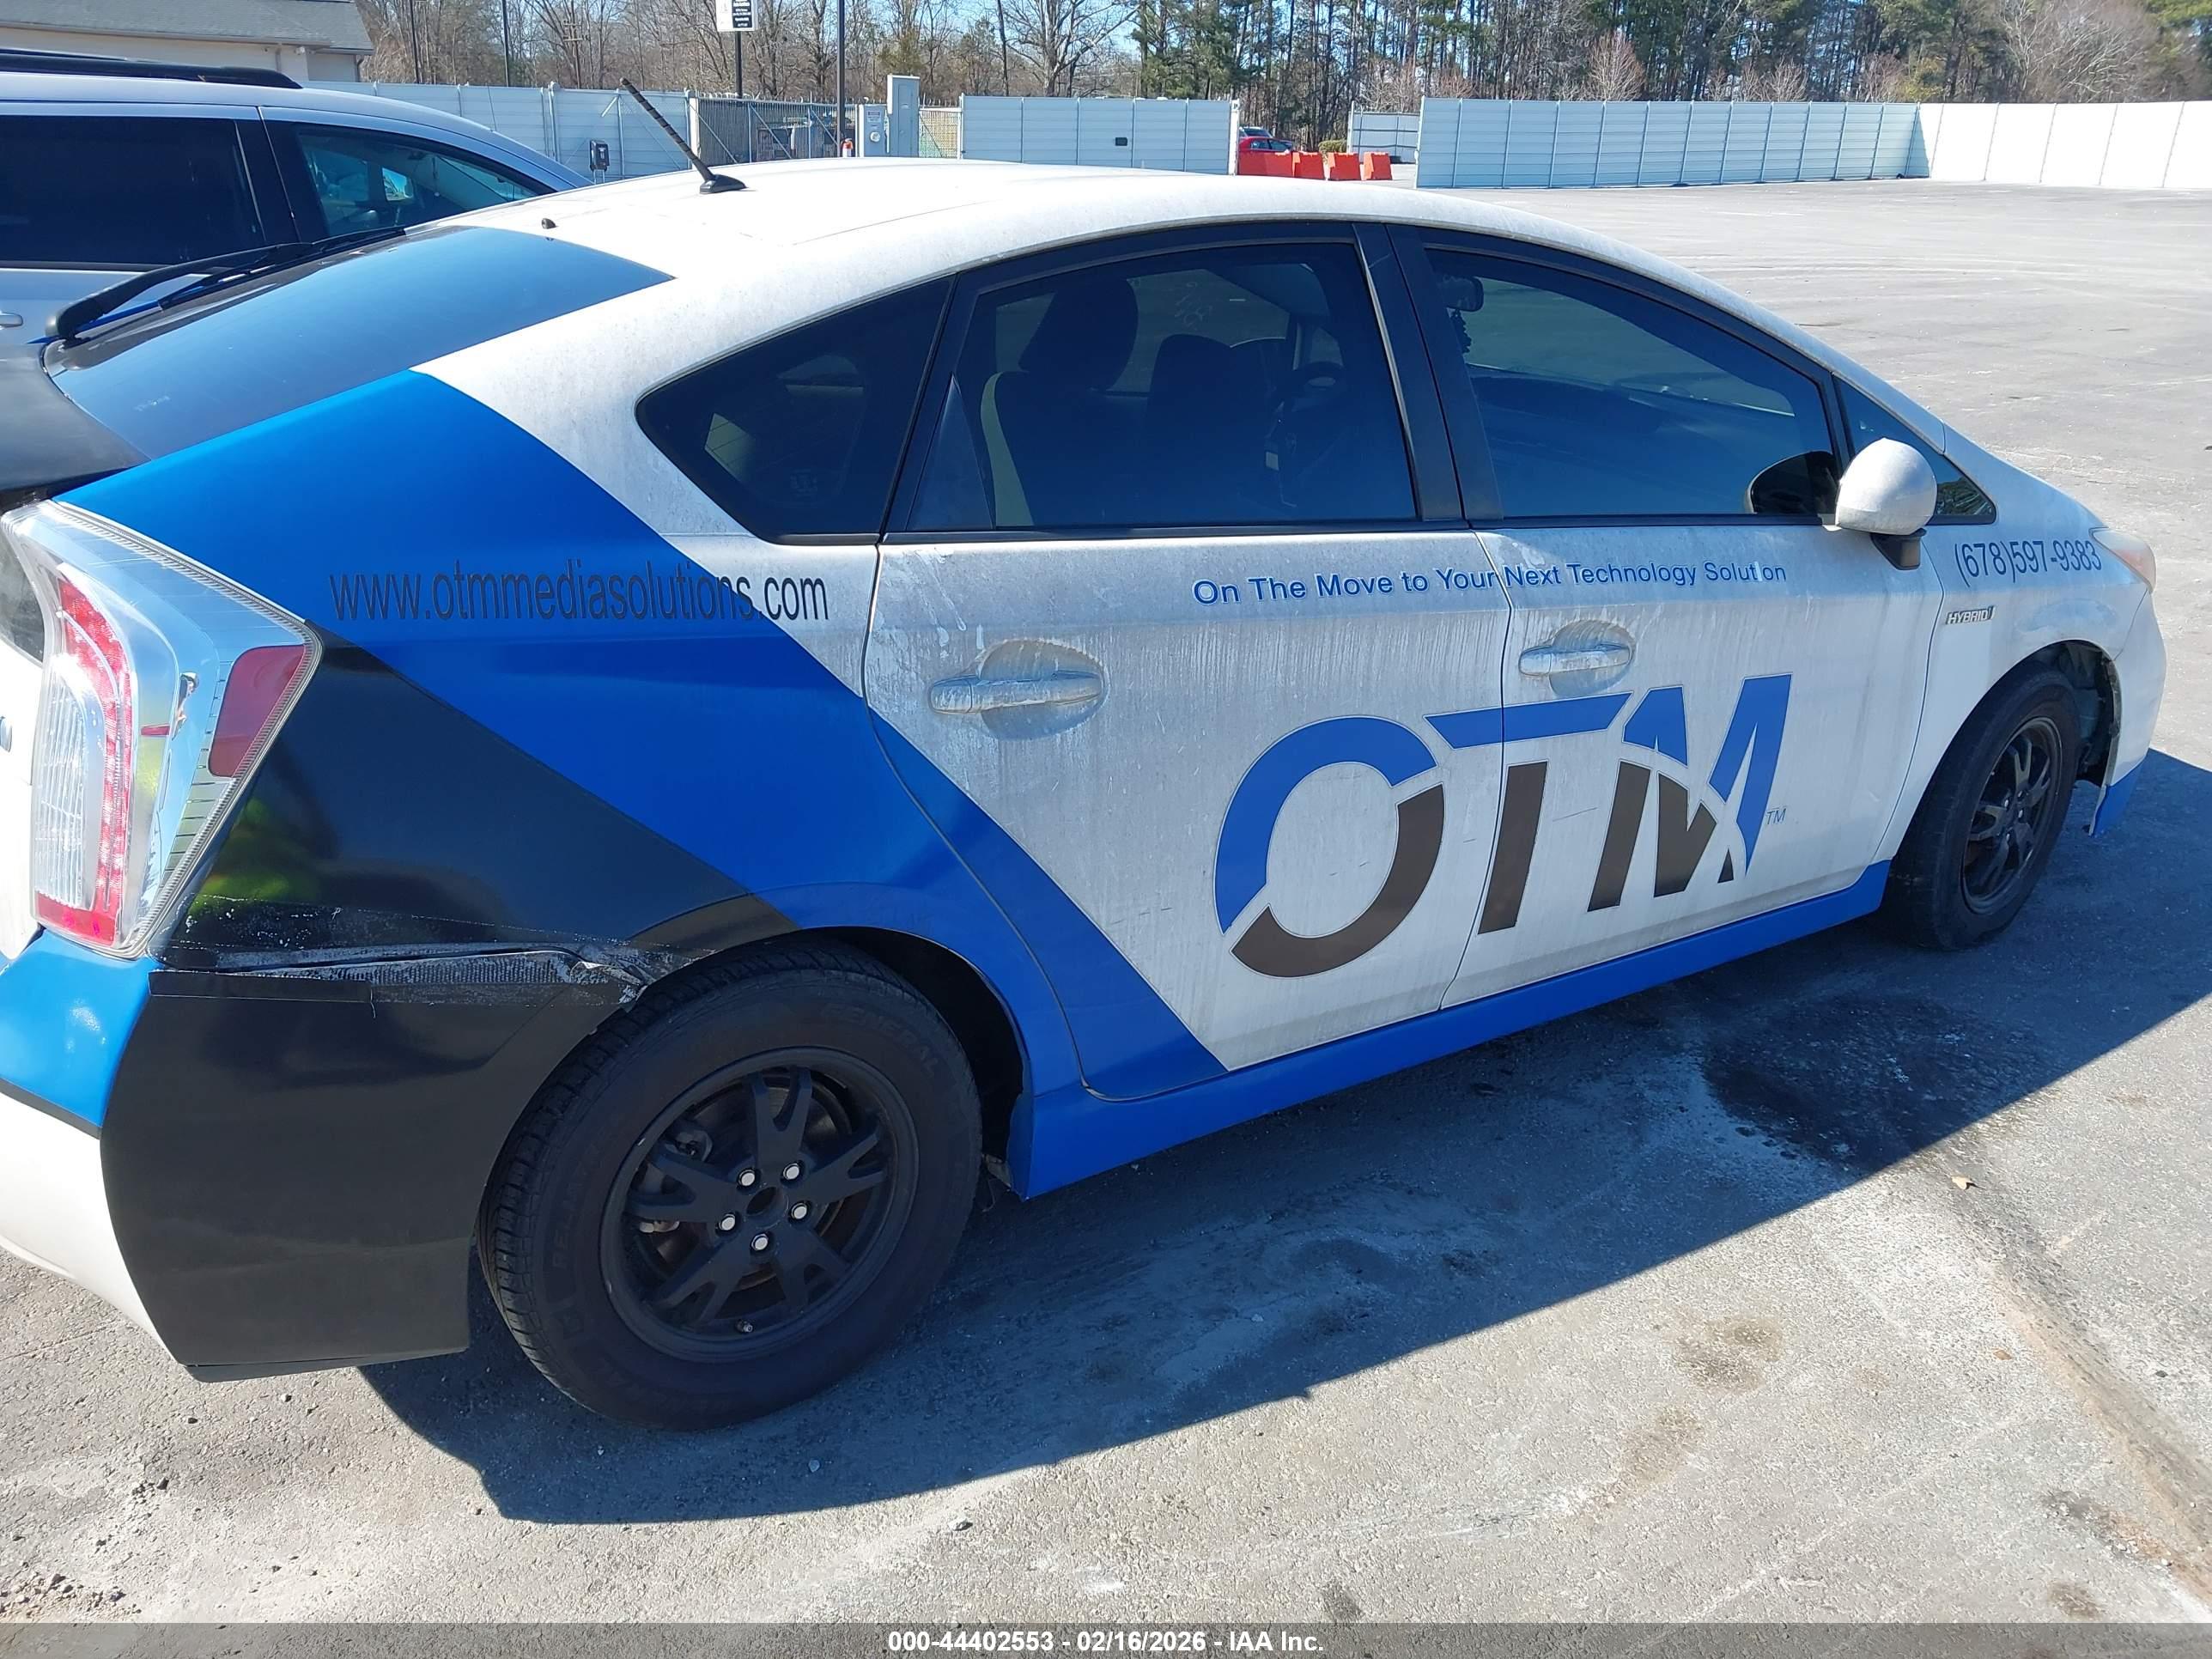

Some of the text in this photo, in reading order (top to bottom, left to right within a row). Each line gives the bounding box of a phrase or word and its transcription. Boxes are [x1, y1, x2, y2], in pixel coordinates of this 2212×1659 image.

[1193, 580, 1241, 605] On
[1248, 577, 1306, 601] The
[1315, 573, 1394, 598] Move
[1401, 570, 1429, 592] to
[1435, 567, 1496, 591] Your
[1504, 565, 1559, 586] Next
[1566, 562, 1697, 586] Technology
[1954, 540, 2102, 587] (678)597-9383
[329, 559, 830, 621] www.otmmediasolutions.com
[1945, 606, 1994, 625] HYBRID
[1213, 672, 1792, 979] OTM TM
